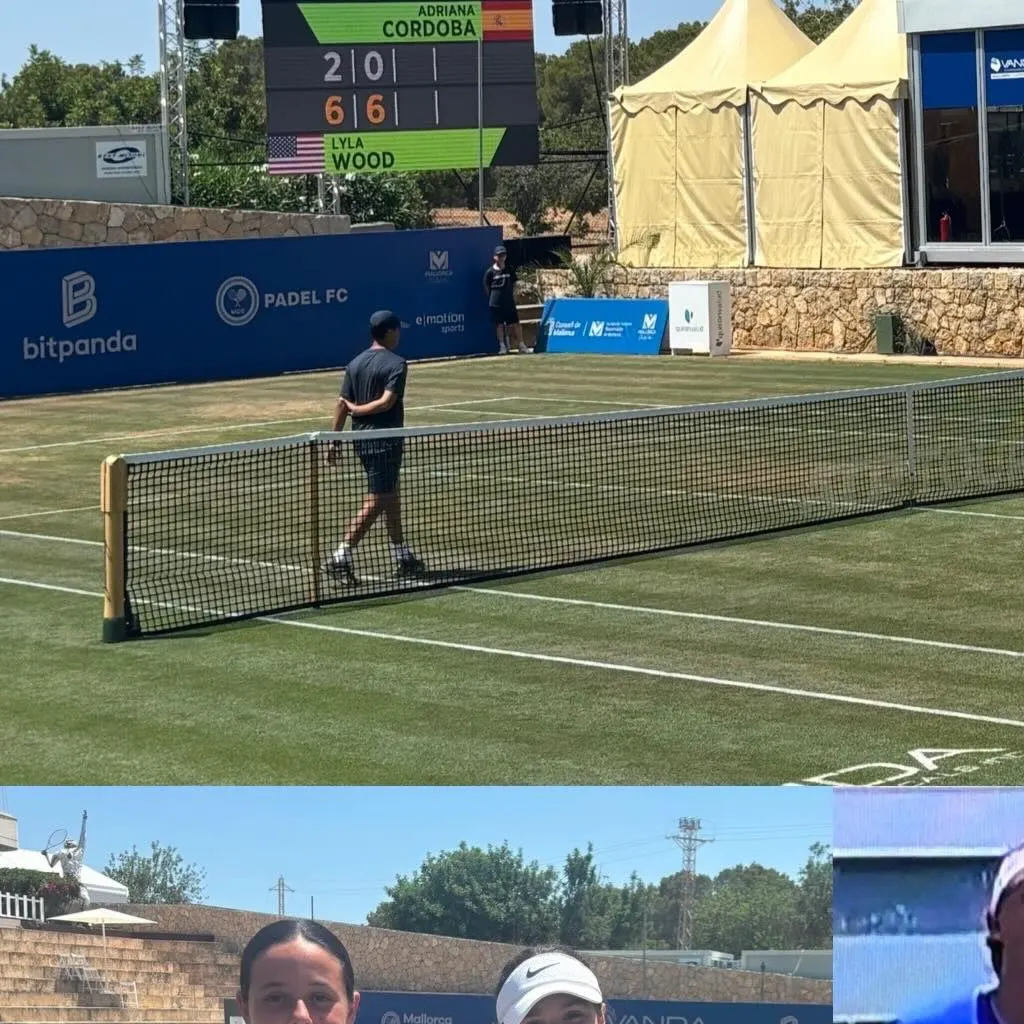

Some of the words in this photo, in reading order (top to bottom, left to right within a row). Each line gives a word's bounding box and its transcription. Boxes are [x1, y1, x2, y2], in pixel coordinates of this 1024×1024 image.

[418, 4, 475, 17] ADRIANA
[382, 19, 477, 38] CORDOBA
[324, 51, 342, 82] 2
[364, 50, 384, 81] 0
[325, 95, 345, 126] 6
[366, 94, 386, 124] 6
[332, 137, 364, 150] LYLA
[332, 152, 395, 170] WOOD
[264, 290, 321, 308] PADEL
[326, 288, 348, 304] FC
[23, 330, 137, 363] bitpanda
[403, 1013, 453, 1024] Mallorca
